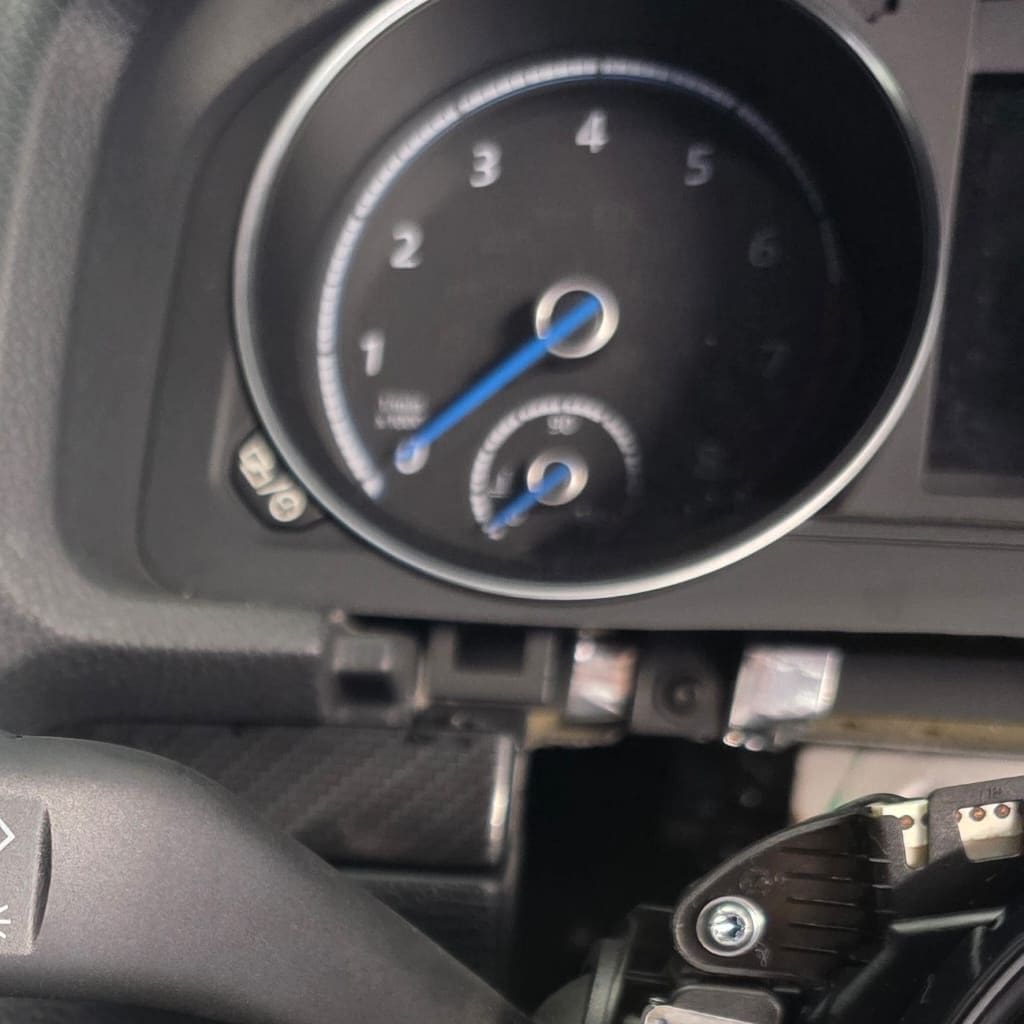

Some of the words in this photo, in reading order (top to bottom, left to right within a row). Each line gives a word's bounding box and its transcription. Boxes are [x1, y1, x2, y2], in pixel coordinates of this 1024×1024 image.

[576, 109, 609, 153] 4
[470, 141, 502, 188] 3
[684, 144, 715, 186] 5
[390, 223, 423, 269] 2
[749, 228, 781, 267] 6
[360, 330, 385, 376] 1
